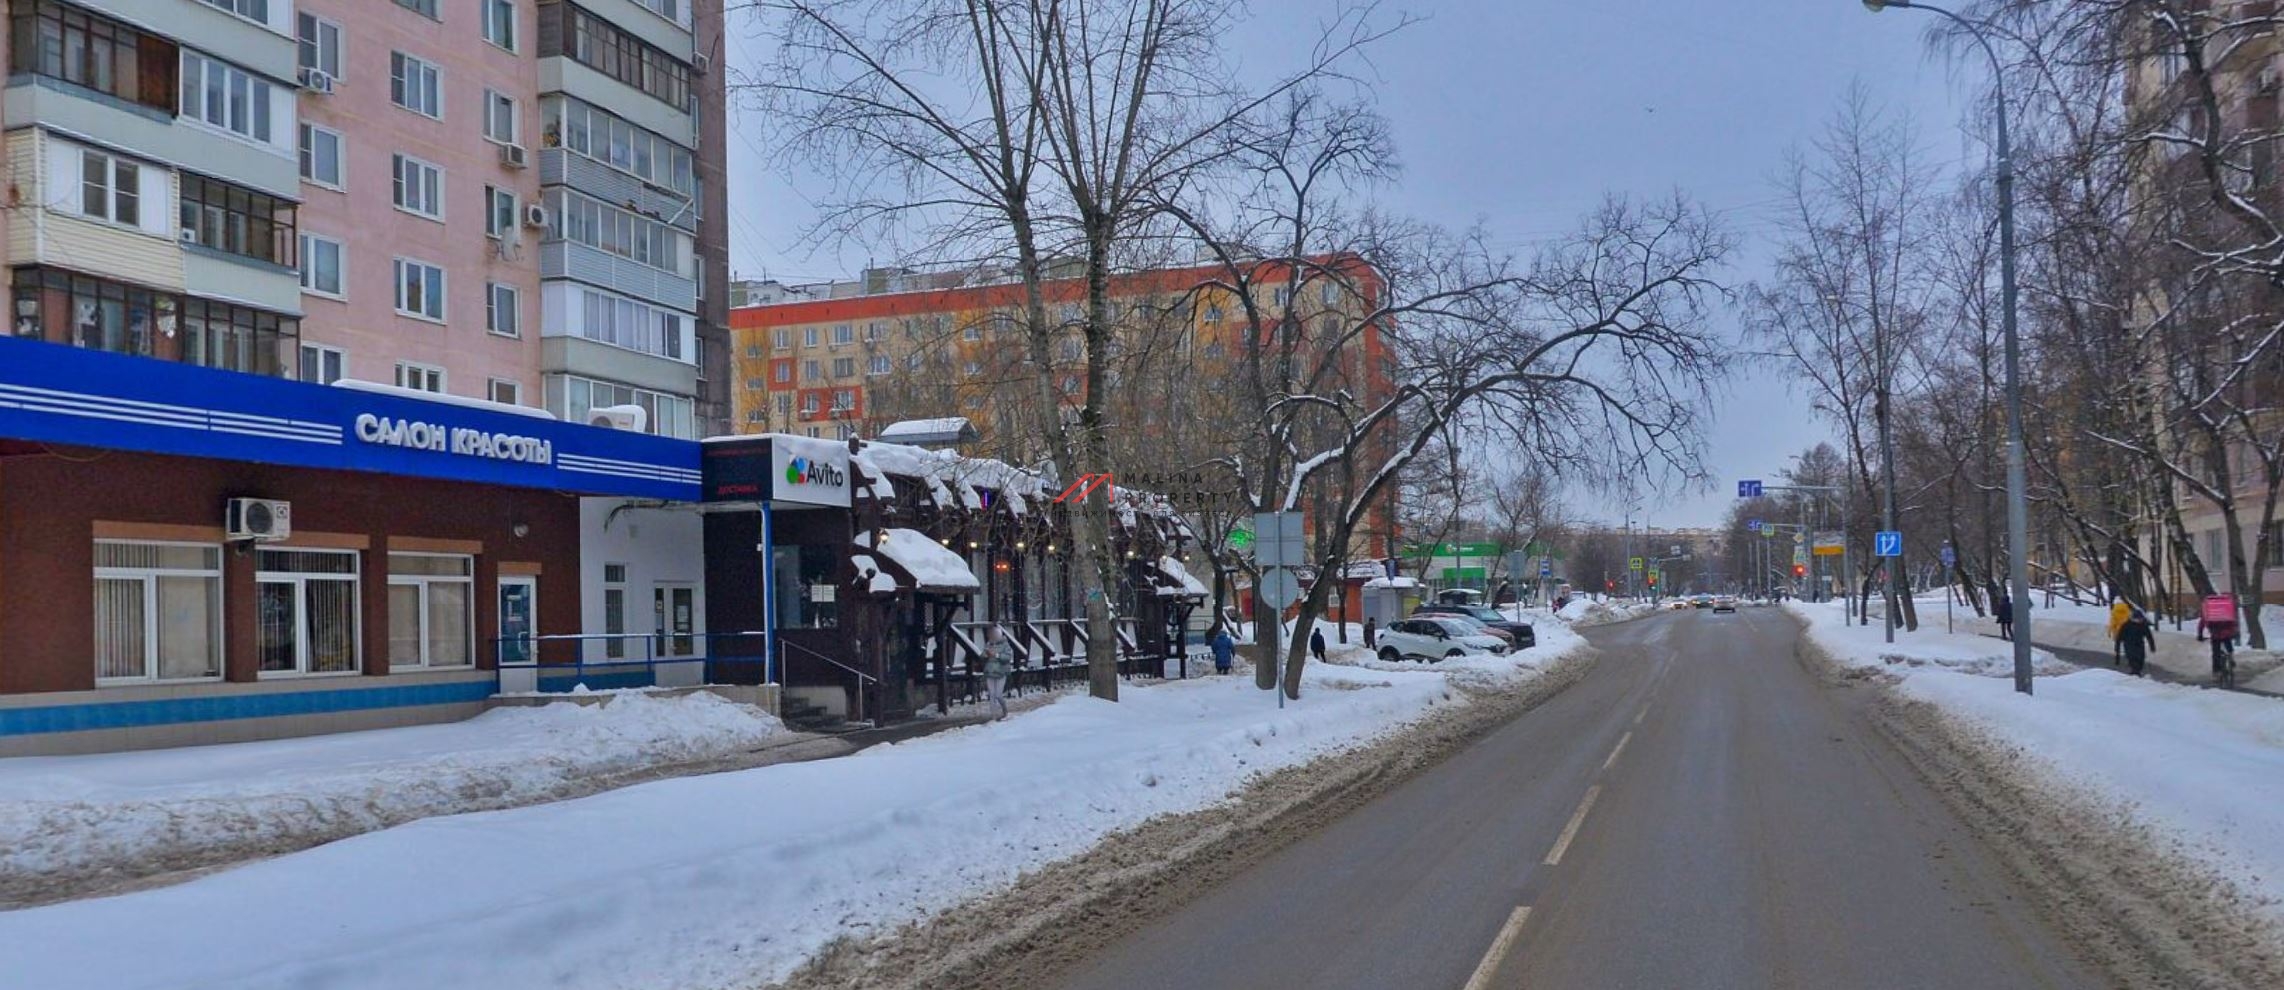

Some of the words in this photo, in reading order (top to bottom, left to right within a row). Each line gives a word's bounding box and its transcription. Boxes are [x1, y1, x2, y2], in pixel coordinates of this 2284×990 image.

[355, 413, 446, 451] САЛОН
[451, 427, 552, 464] КРАСОТЫ
[806, 460, 844, 487] Avito
